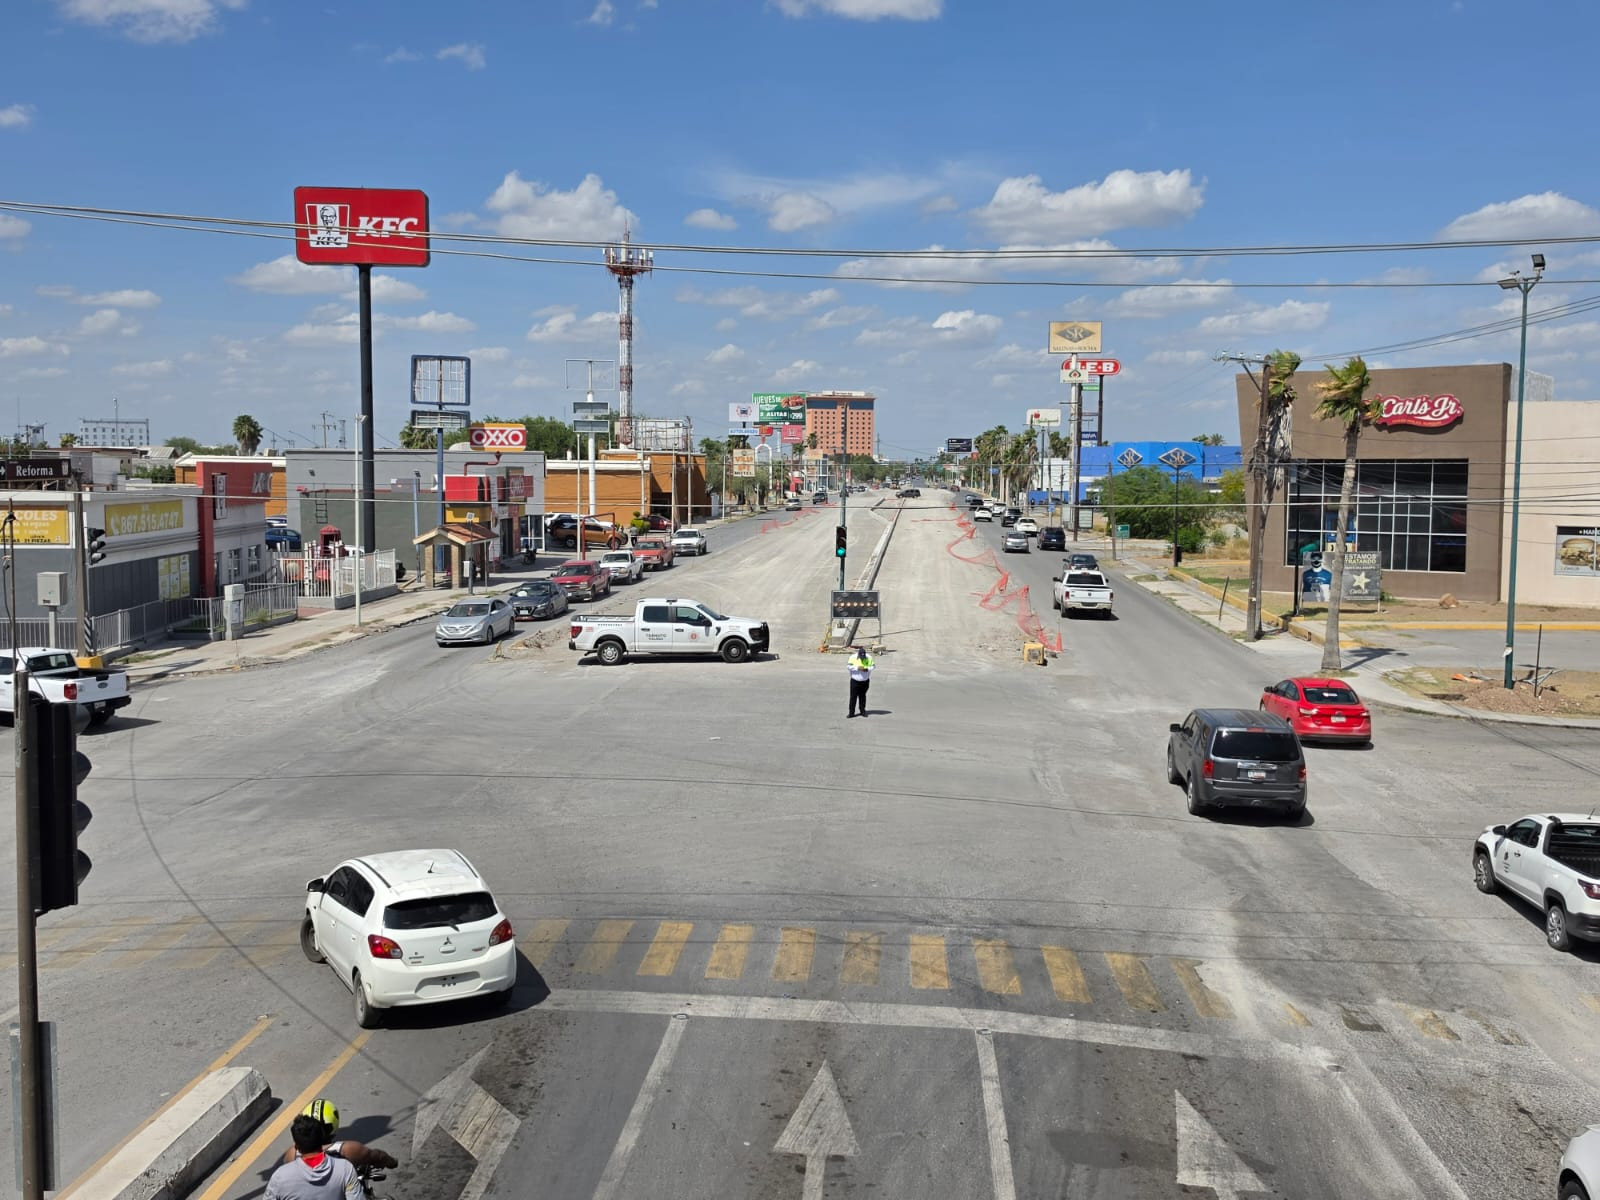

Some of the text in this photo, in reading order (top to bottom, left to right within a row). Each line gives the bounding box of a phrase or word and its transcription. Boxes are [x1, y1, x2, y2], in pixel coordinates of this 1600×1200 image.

[355, 216, 418, 238] KFC
[315, 236, 343, 246] KFC
[1381, 396, 1461, 418] Carl's Jr.
[472, 429, 523, 446] OXXO
[16, 464, 54, 477] Reforma
